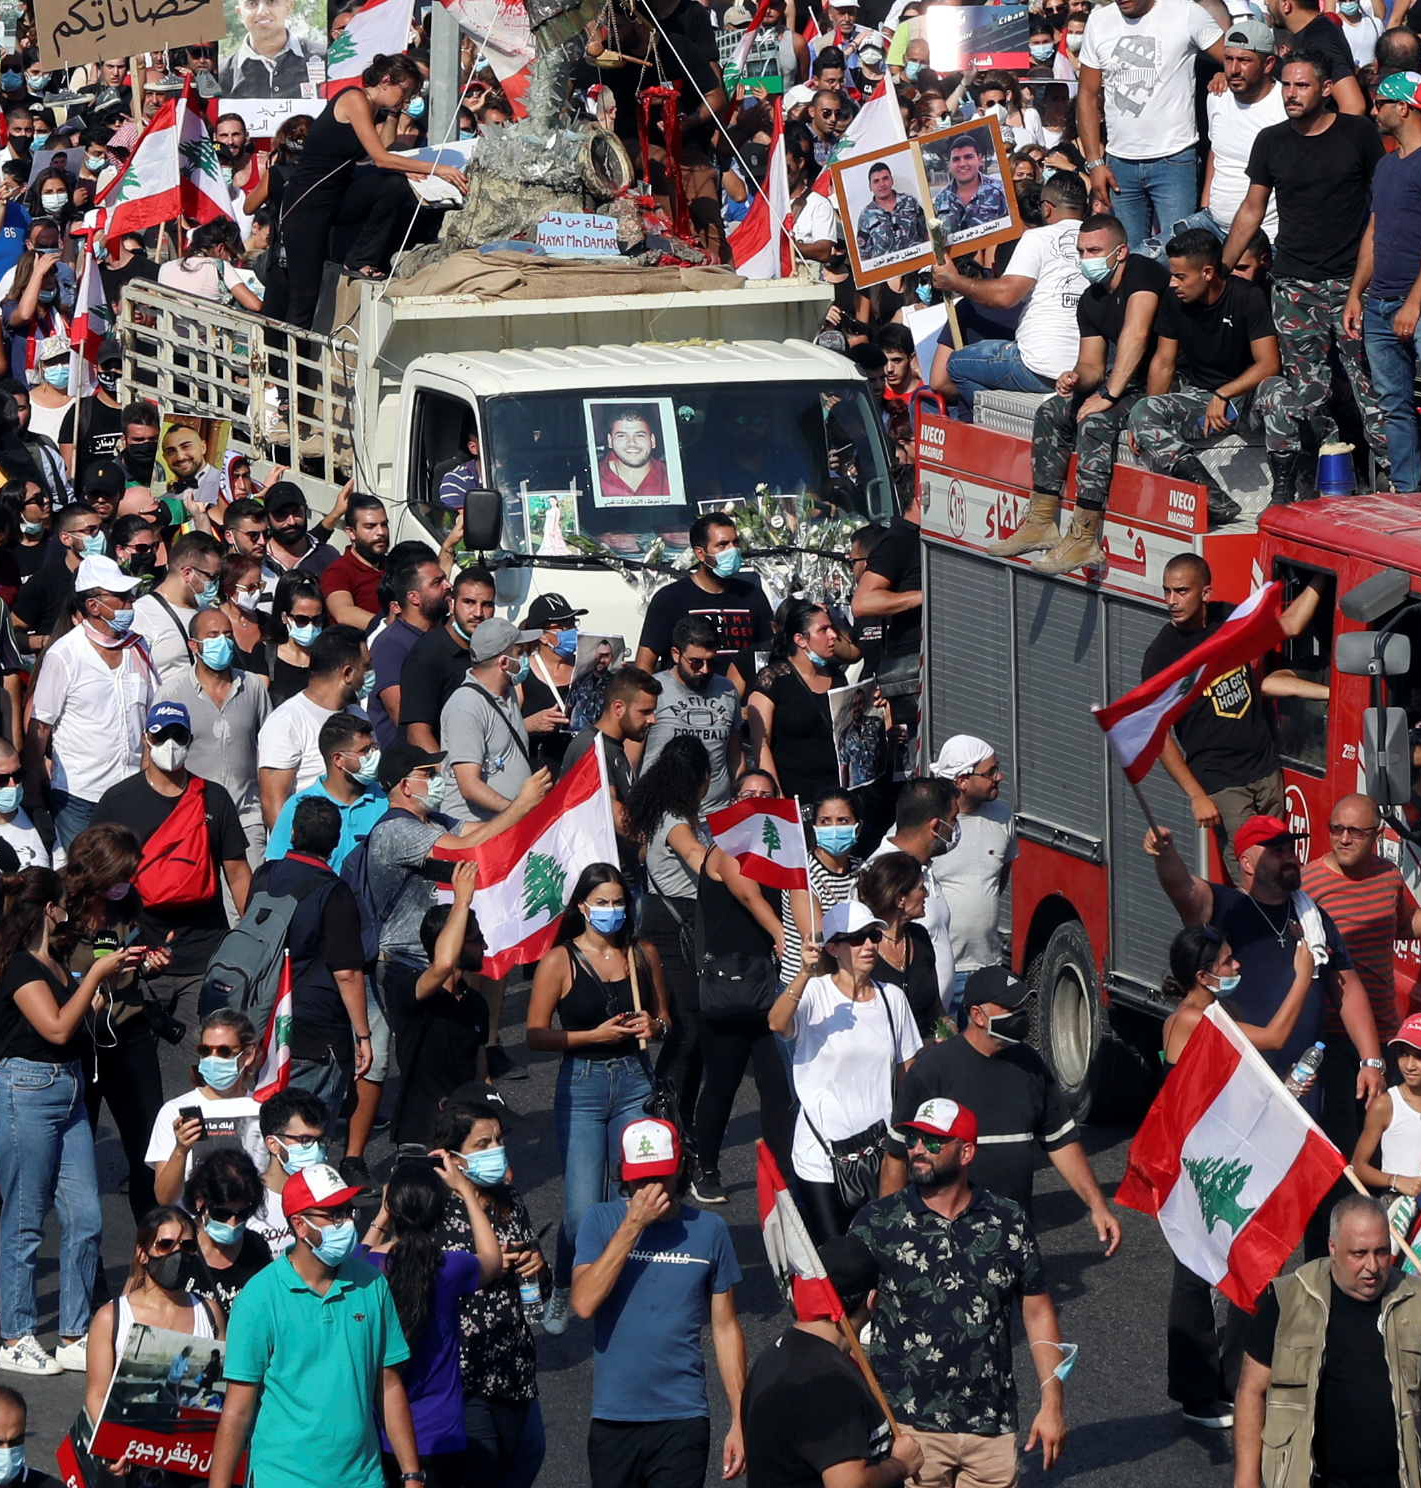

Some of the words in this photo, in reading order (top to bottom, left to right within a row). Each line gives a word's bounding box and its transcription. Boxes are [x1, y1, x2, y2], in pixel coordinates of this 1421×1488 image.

[538, 212, 562, 225] دمار
[565, 218, 580, 228] من
[585, 215, 614, 231] حياة
[3, 227, 17, 238] 86
[980, 222, 1000, 235] البطل
[538, 233, 565, 247] HAYAT
[567, 234, 583, 248] Mn
[583, 235, 618, 249] DAMAR
[901, 247, 921, 260] البطل
[920, 424, 946, 446] IVECO
[95, 437, 115, 450] لبنان
[918, 444, 944, 461] MAGIRUS
[1168, 489, 1196, 512] IVECO
[954, 494, 965, 526] 175
[1167, 510, 1194, 529] MAGIRUS
[1215, 680, 1230, 697] OR
[1229, 672, 1243, 690] GO
[1218, 687, 1248, 711] HOME
[628, 1250, 691, 1265] RIGINALS
[124, 1438, 165, 1465] وجوع
